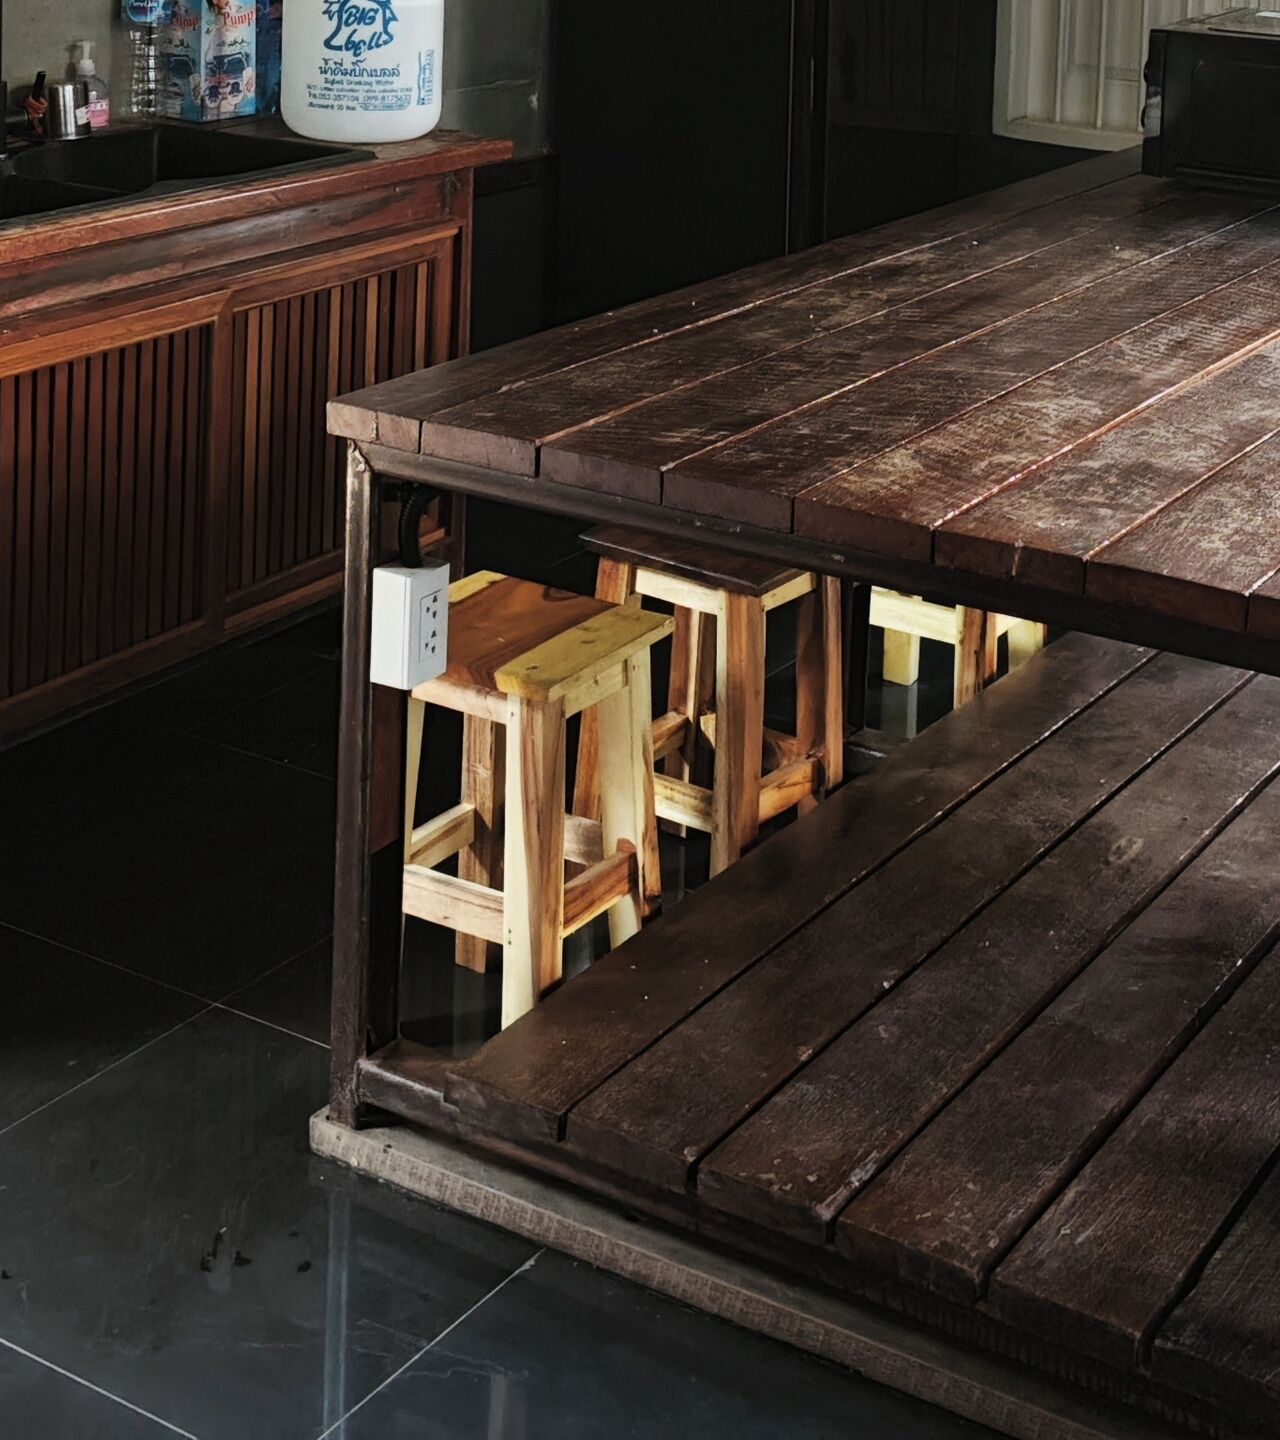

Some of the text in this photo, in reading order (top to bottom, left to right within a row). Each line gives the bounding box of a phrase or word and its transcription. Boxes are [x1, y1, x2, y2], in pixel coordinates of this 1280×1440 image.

[223, 9, 255, 27] Pump
[343, 5, 379, 27] BIG
[344, 29, 384, 57] bell
